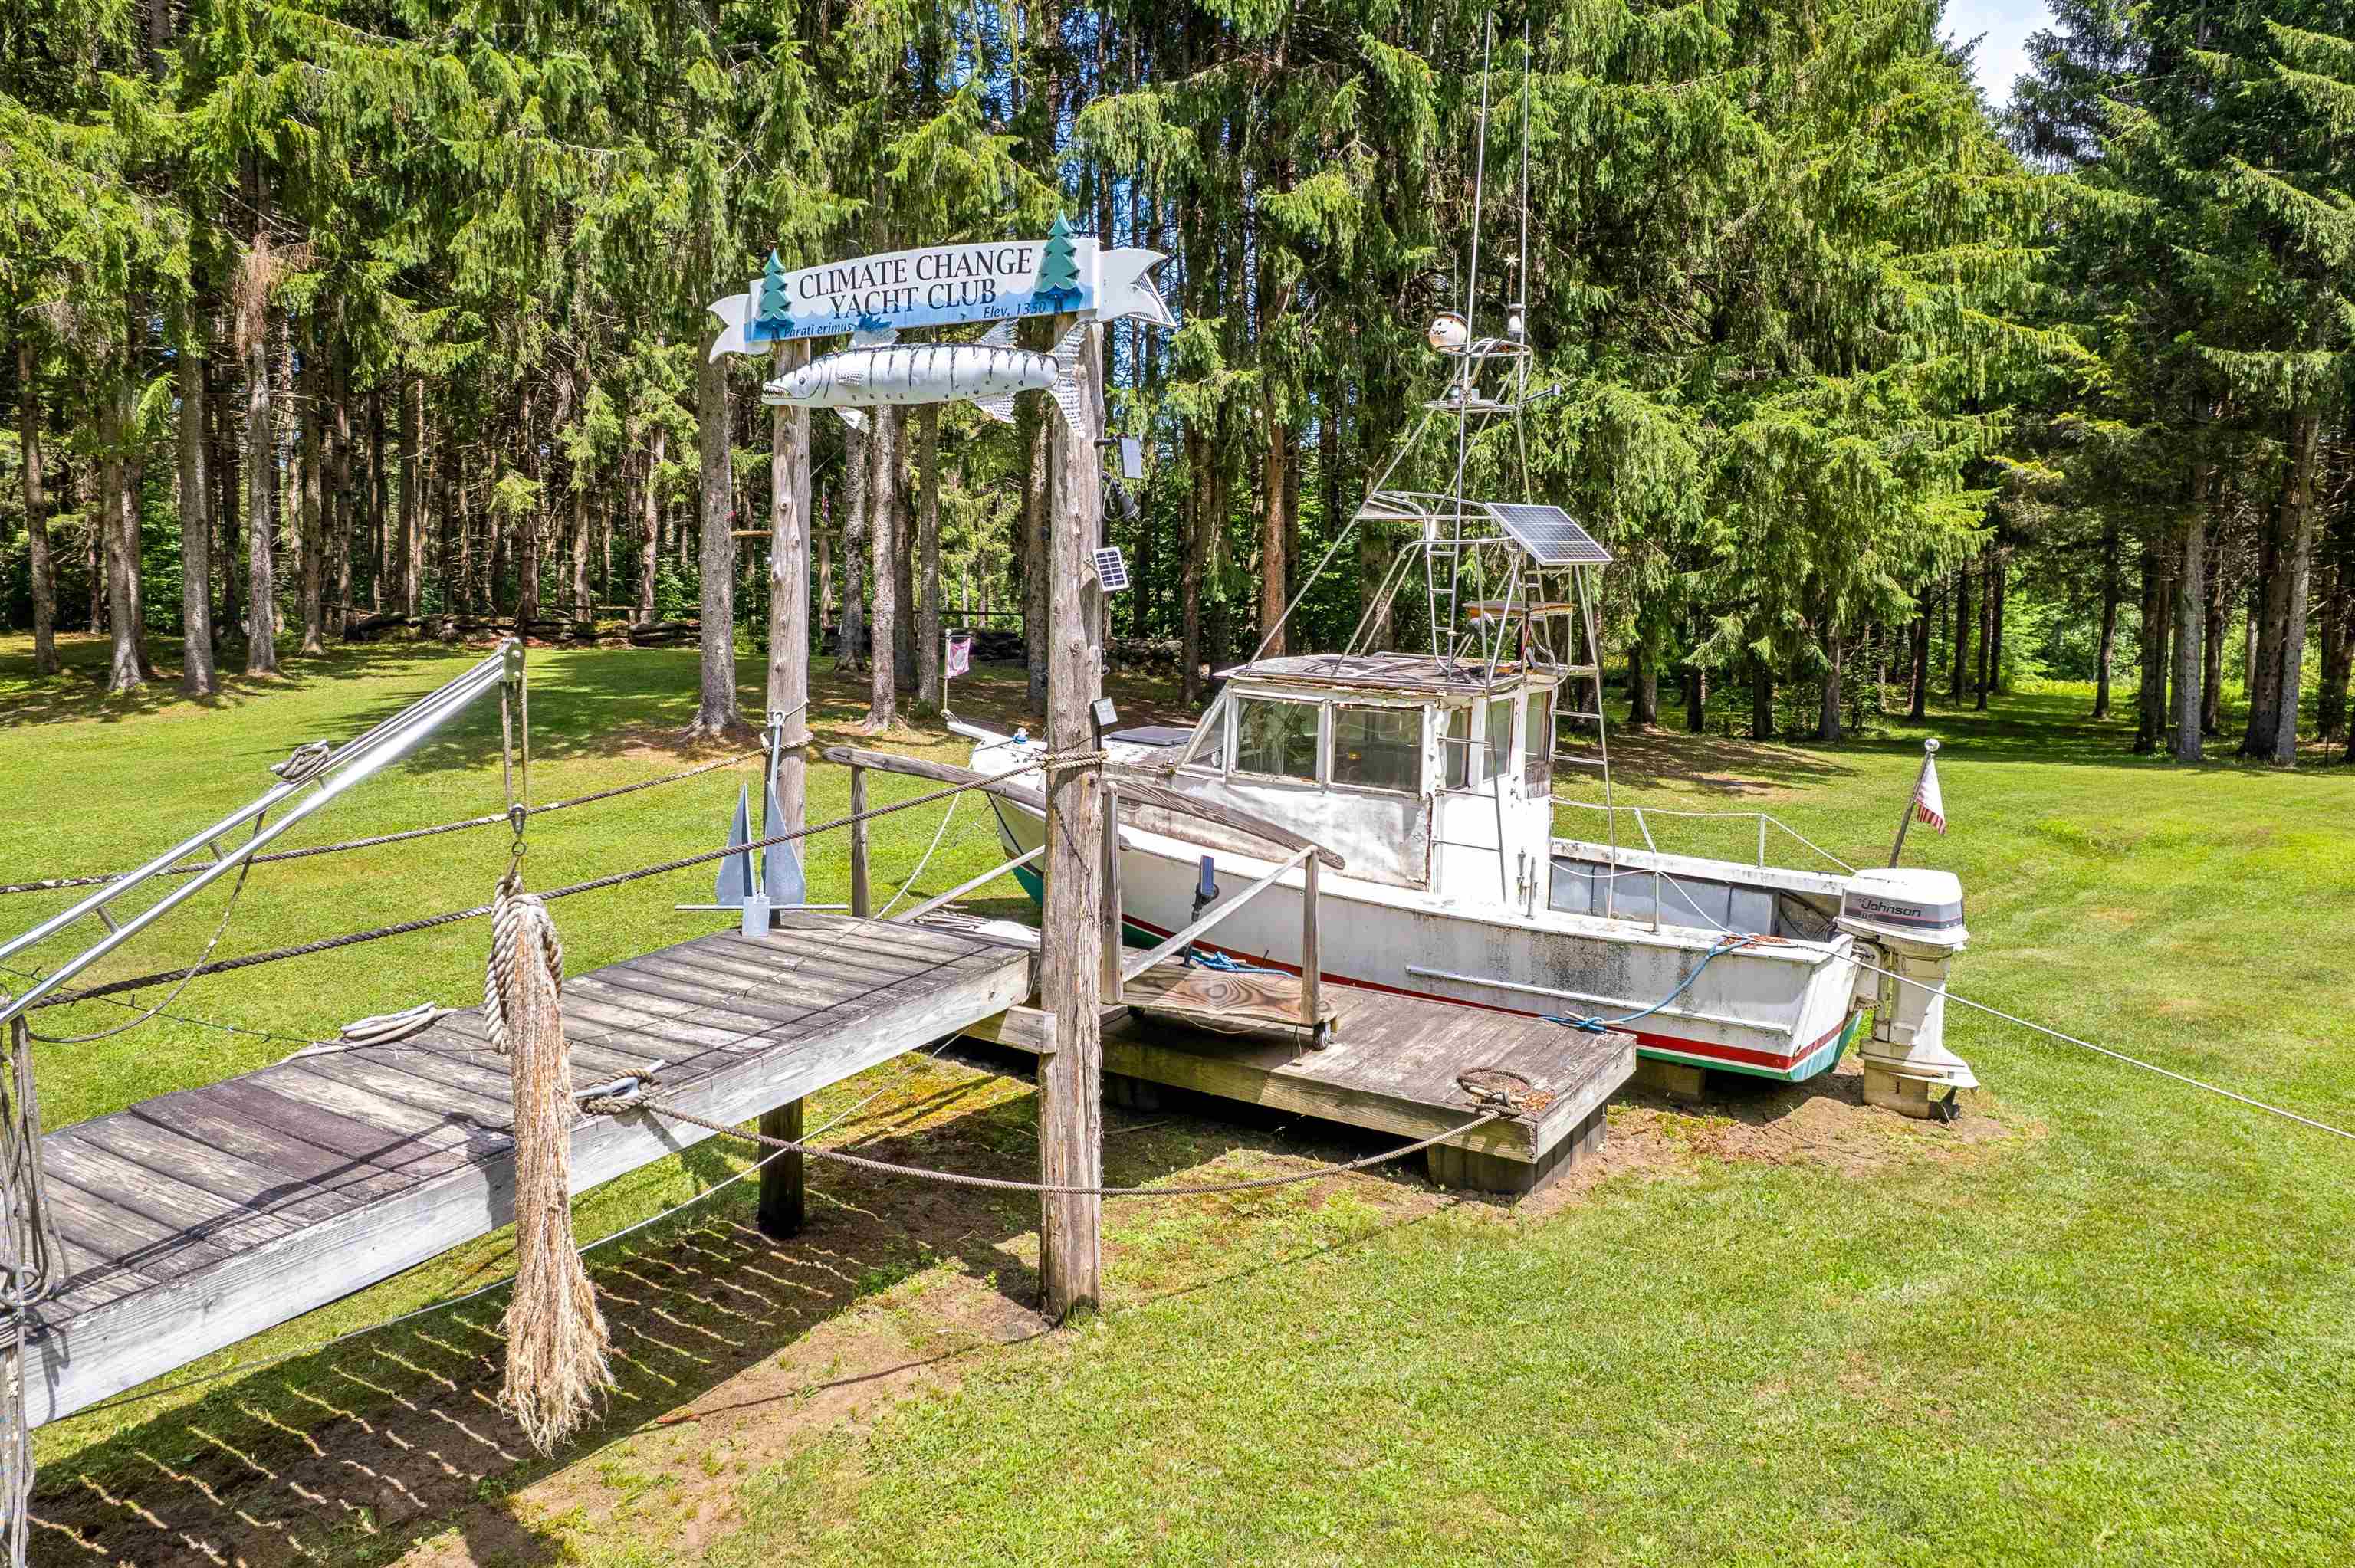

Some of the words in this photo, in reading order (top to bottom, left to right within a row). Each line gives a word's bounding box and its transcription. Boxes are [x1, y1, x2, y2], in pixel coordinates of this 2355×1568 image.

[799, 258, 907, 299] CLIMATE
[915, 248, 1033, 280] CHANGE
[829, 287, 919, 319] YACHT
[928, 278, 996, 310] CLUB
[984, 306, 1010, 318] Elev.
[784, 324, 815, 338] Parati
[817, 320, 852, 335] erimus
[1860, 899, 1921, 917] Johnson
